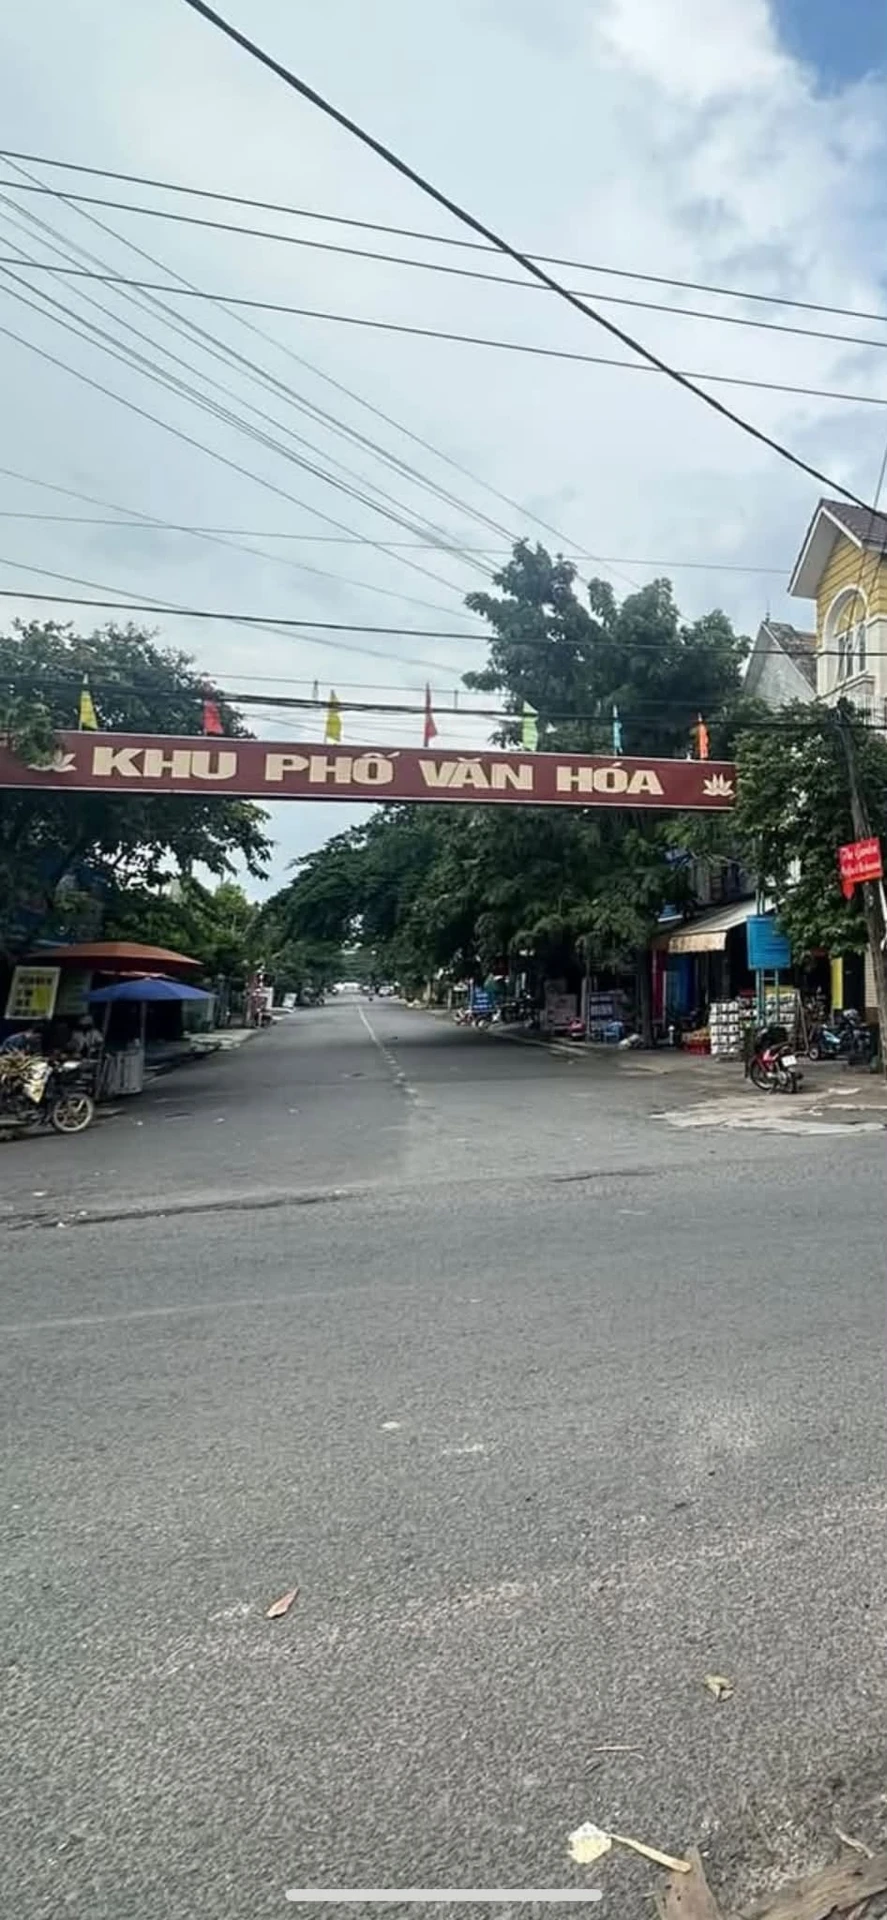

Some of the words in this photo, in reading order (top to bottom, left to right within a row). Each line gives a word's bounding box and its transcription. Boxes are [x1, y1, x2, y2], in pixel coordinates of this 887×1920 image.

[92, 746, 237, 780] KHU
[264, 751, 401, 785] PHỐ
[419, 757, 533, 791] VĂN
[556, 762, 664, 795] HÓA
